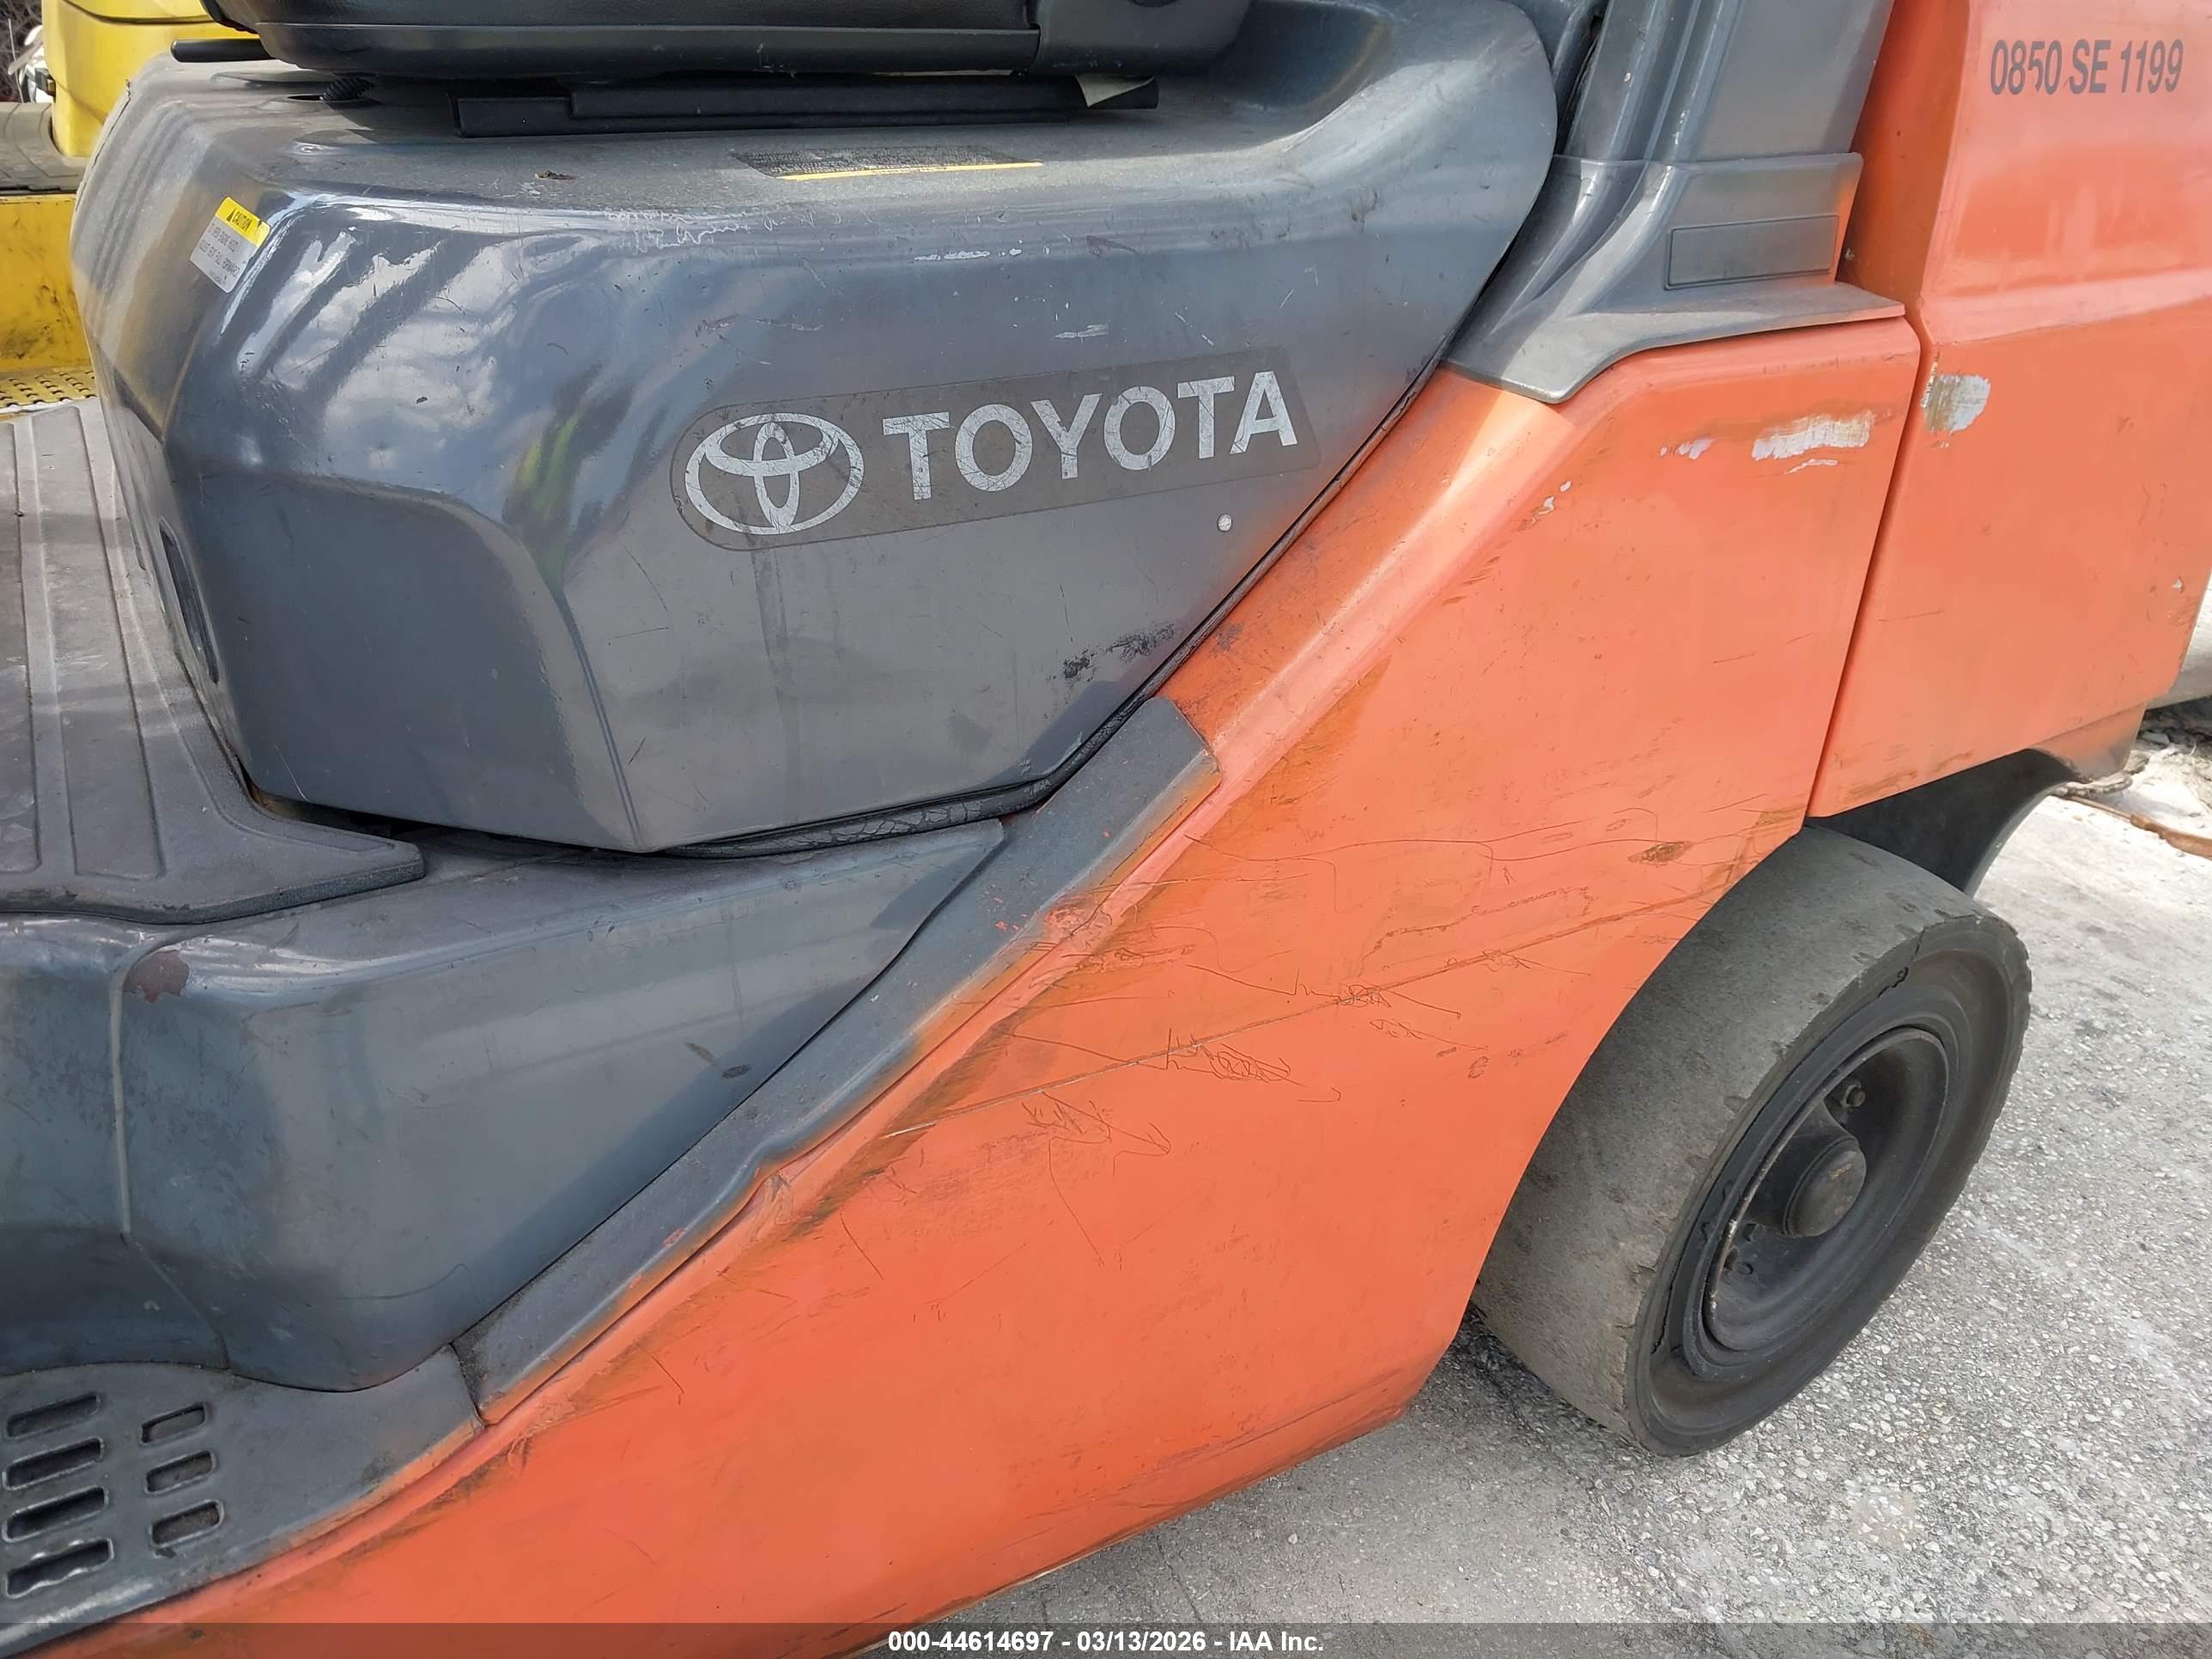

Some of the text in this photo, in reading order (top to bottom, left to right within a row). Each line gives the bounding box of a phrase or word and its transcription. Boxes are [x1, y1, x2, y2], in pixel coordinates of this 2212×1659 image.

[1990, 38, 2185, 95] 0850 SE 1199
[232, 211, 252, 232] CAUTION
[882, 370, 1297, 501] TOYOTA
